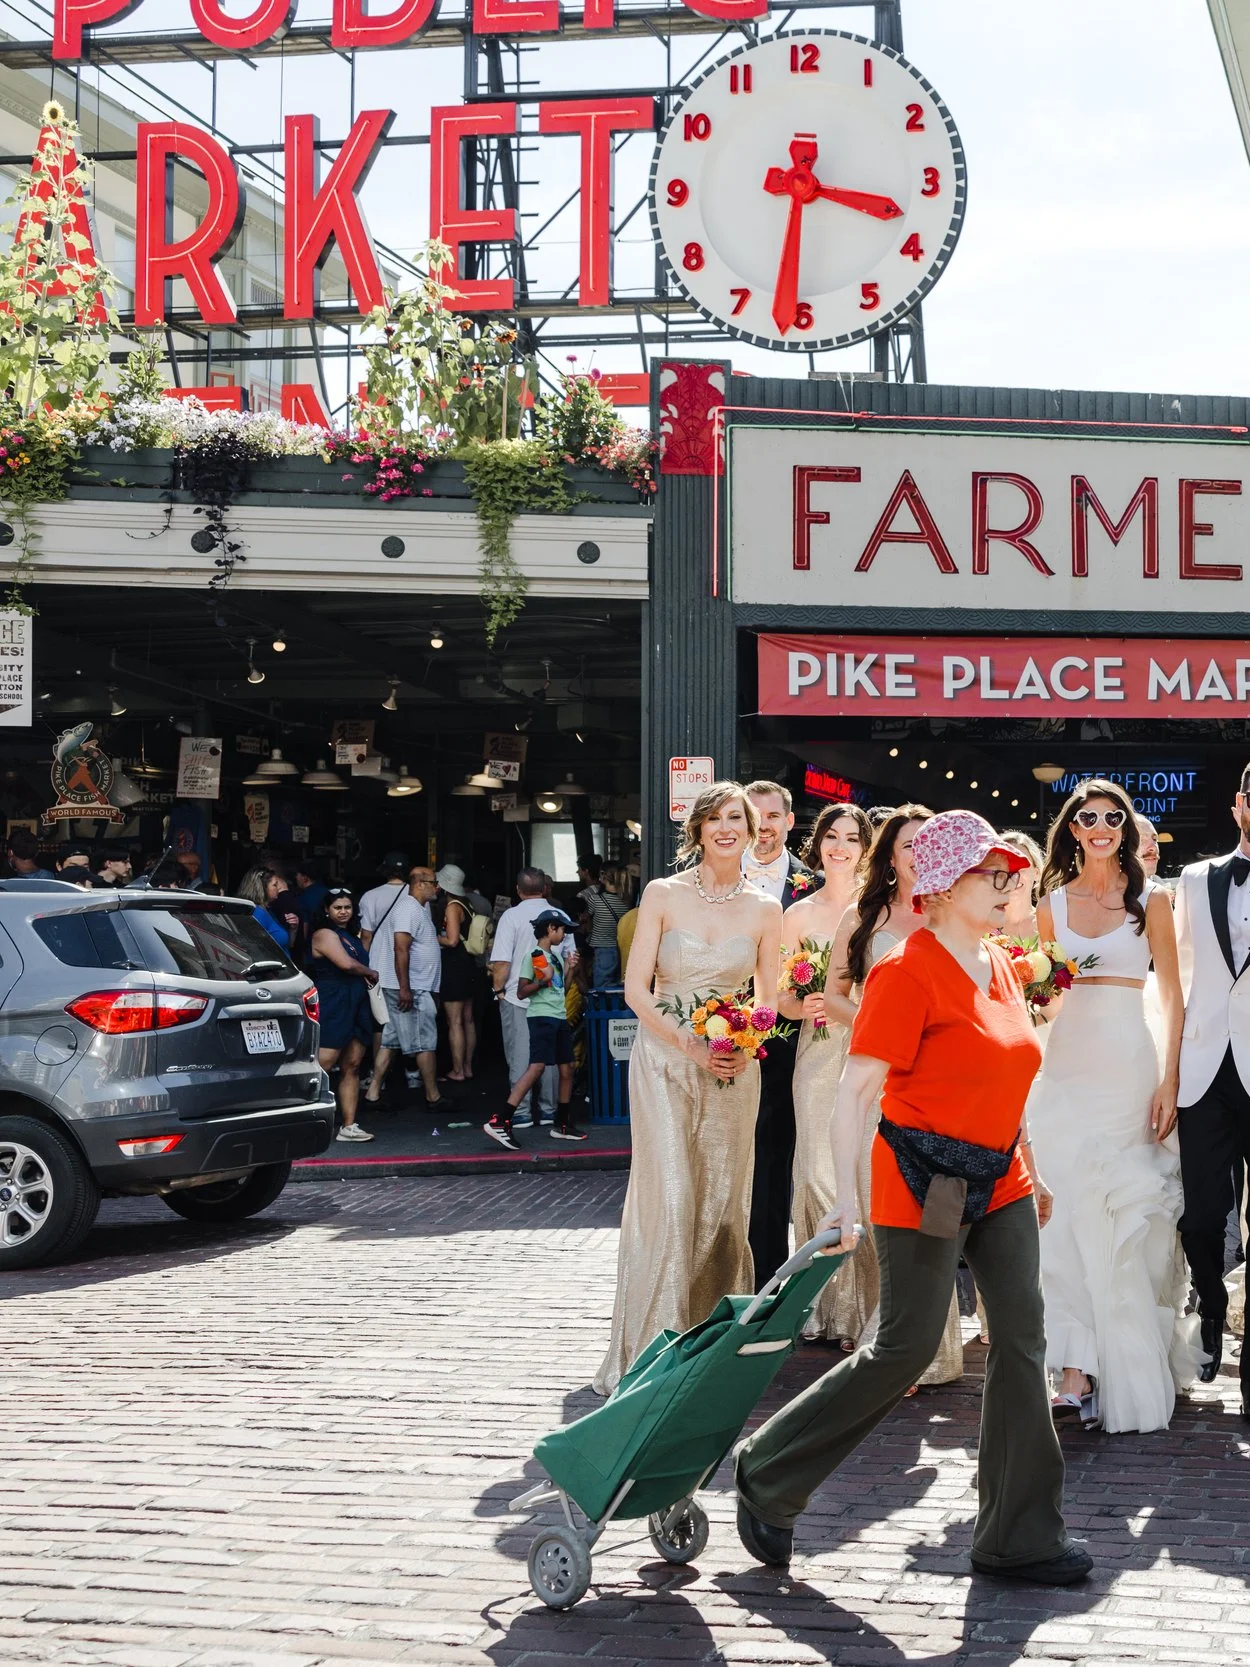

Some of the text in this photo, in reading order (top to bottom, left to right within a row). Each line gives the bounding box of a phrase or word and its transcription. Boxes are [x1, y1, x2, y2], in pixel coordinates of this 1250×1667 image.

[790, 43, 820, 74] 12
[864, 58, 873, 88] 1
[730, 64, 752, 95] 11
[683, 113, 712, 143] 10
[906, 103, 925, 133] 2
[667, 178, 690, 208] 9
[921, 167, 941, 199] 3
[682, 242, 705, 272] 8
[900, 232, 925, 263] 4
[730, 288, 752, 317] 7
[860, 283, 881, 312] 5
[797, 302, 815, 332] 6
[788, 651, 917, 698] PIKE
[943, 655, 1126, 700] PLACE
[673, 760, 685, 769] NO
[676, 773, 708, 783] STOPS
[55, 759, 110, 802] PIKE PLACE FISH MARKET
[50, 808, 117, 817] WORLD FAMOUS
[1132, 797, 1178, 813] OINT
[247, 1030, 282, 1048] BYA2410
